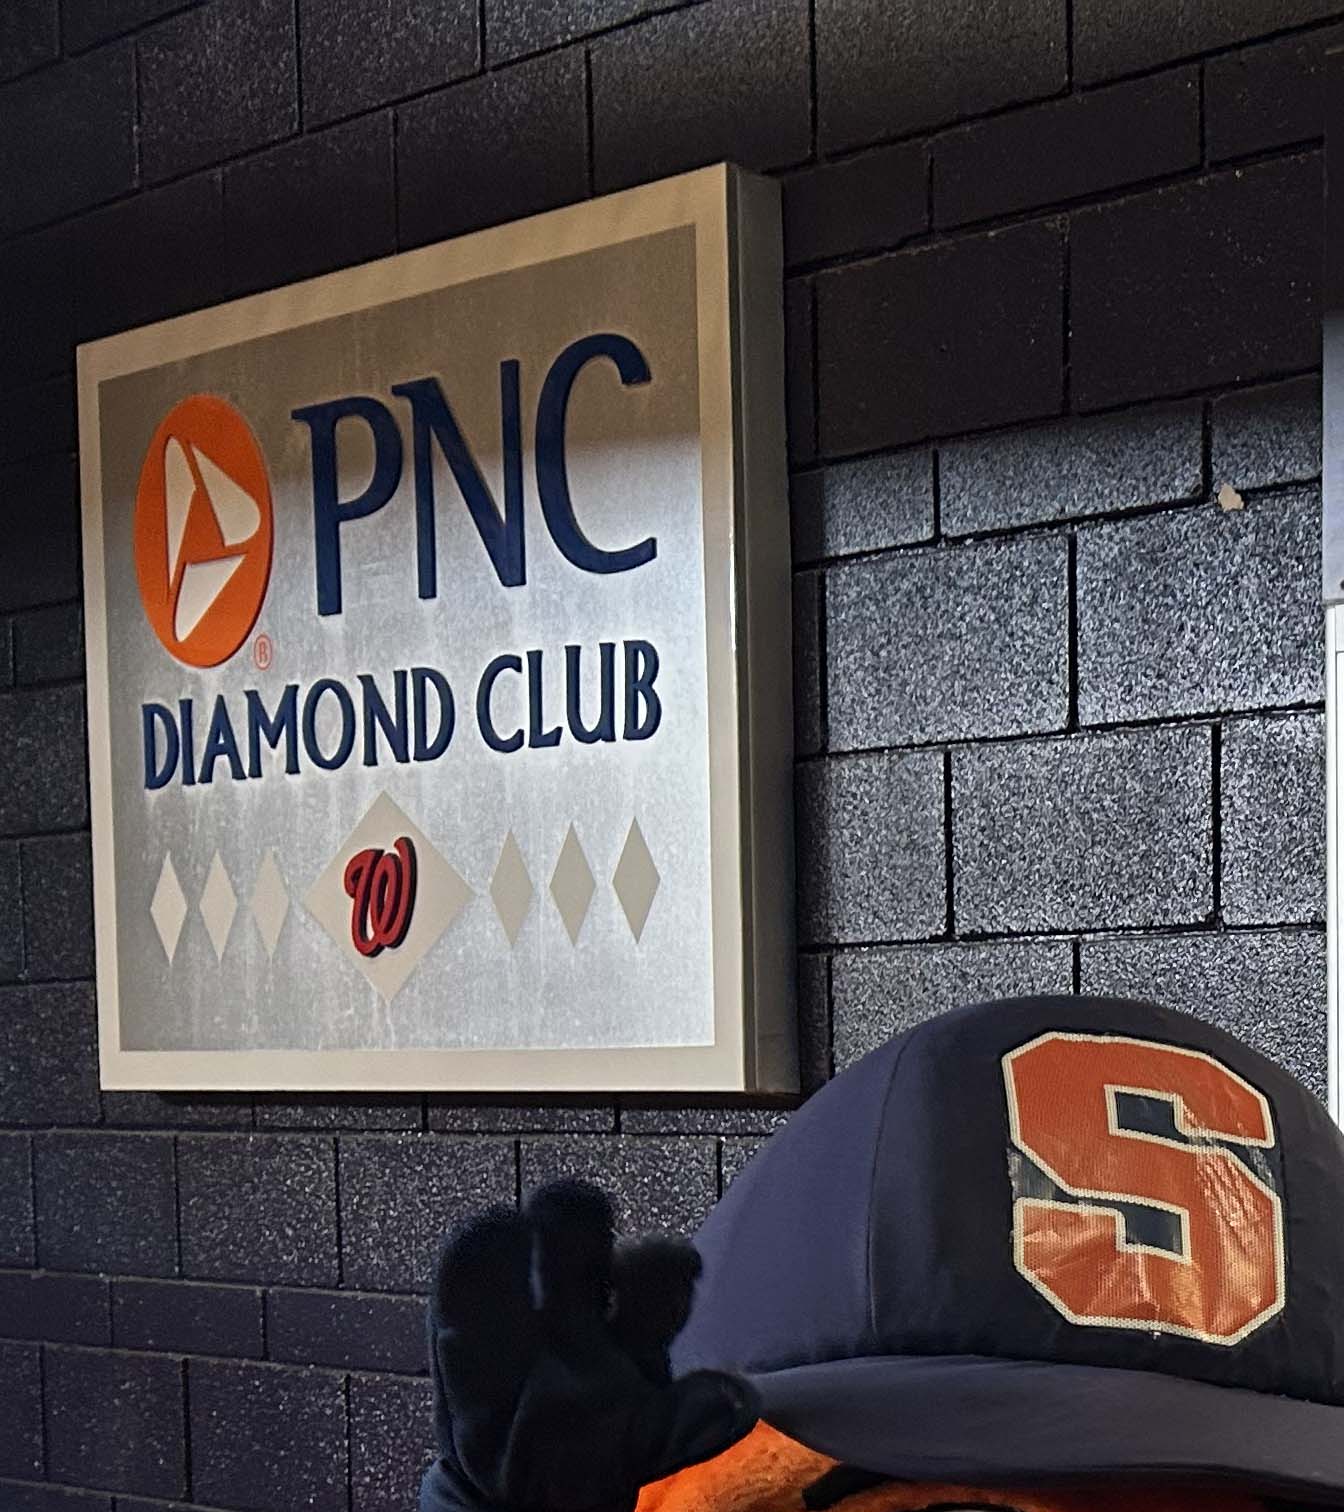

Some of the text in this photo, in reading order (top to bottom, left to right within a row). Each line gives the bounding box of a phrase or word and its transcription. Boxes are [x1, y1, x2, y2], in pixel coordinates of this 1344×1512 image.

[290, 332, 658, 617] PNC
[142, 638, 662, 790] DIAMOND CLUB
[343, 836, 418, 958] W
[1002, 1032, 1286, 1346] S
